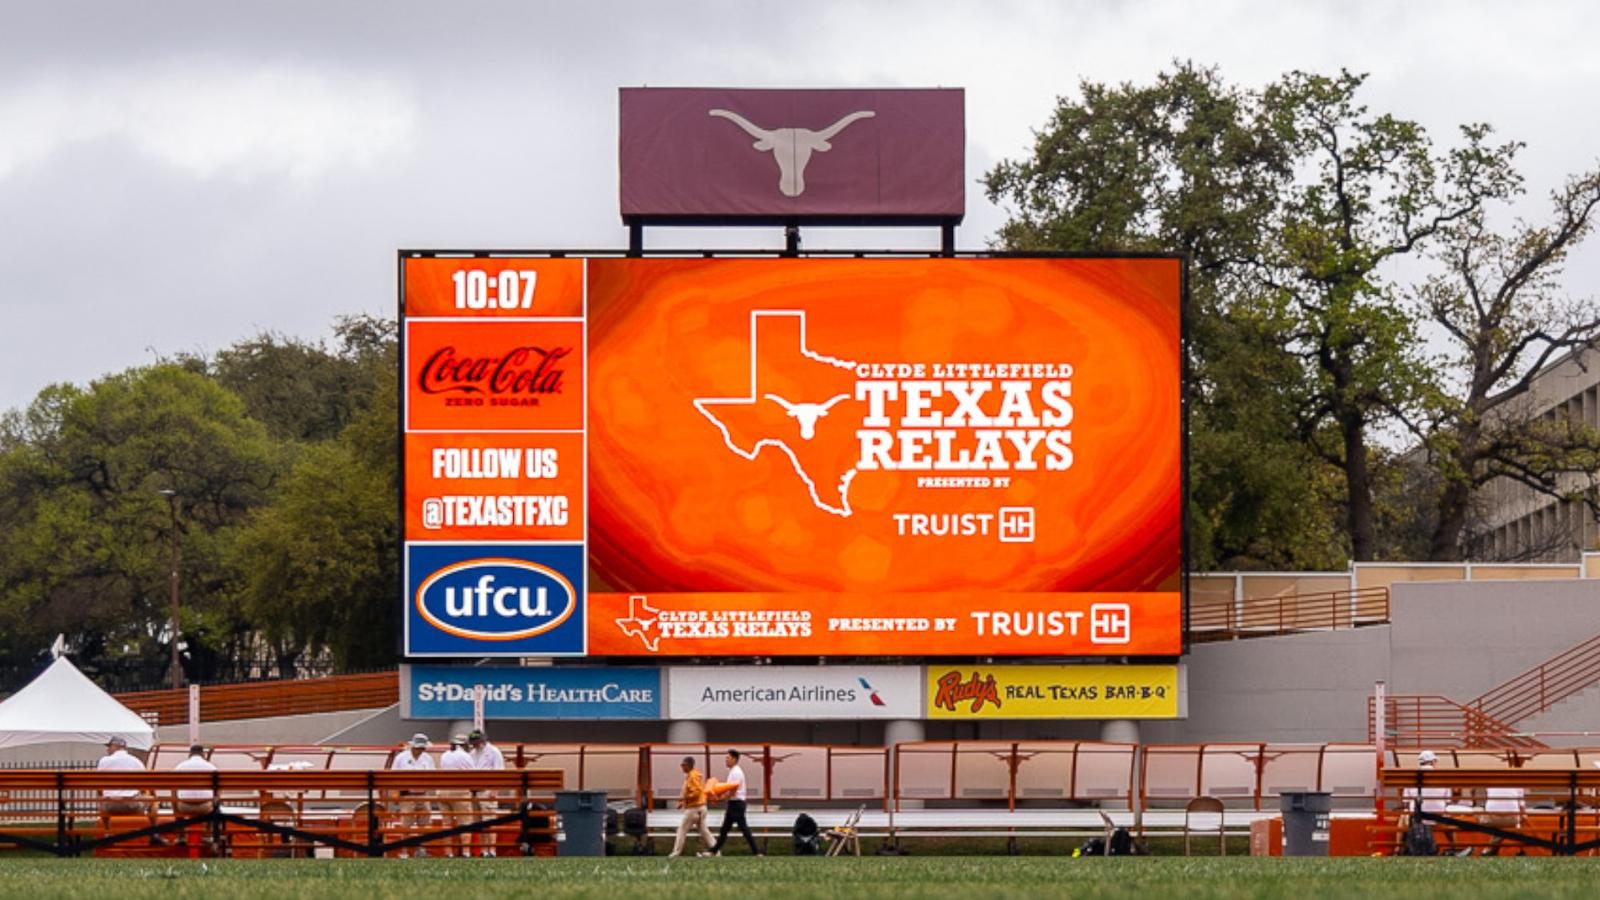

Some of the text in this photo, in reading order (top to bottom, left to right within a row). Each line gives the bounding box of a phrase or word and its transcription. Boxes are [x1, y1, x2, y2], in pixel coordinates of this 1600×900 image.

[452, 269, 537, 310] 10:07
[418, 346, 573, 395] Coca-Cola
[855, 363, 1073, 378] CLYDE LITTLEFIELD
[445, 398, 540, 407] ZERO SUGAR
[855, 380, 1074, 427] TEXAS
[855, 429, 1074, 470] RELAYS
[432, 447, 559, 479] FOLLOW US
[917, 477, 1010, 488] PRESENTED BY
[422, 495, 569, 530] @TEXASTFXC
[893, 513, 994, 536] TRUIST
[445, 574, 549, 618] ufcu
[658, 610, 812, 622] CLYDE LITTLEFIELD
[828, 617, 957, 631] PRESENTED BY
[970, 611, 1085, 636] TRUIST
[657, 621, 812, 637] TEXAS RELAYS
[702, 686, 856, 702] American Airlines
[935, 671, 1001, 712] Rudy's
[1005, 685, 1045, 699] REAL
[1048, 685, 1098, 700] TEXAS
